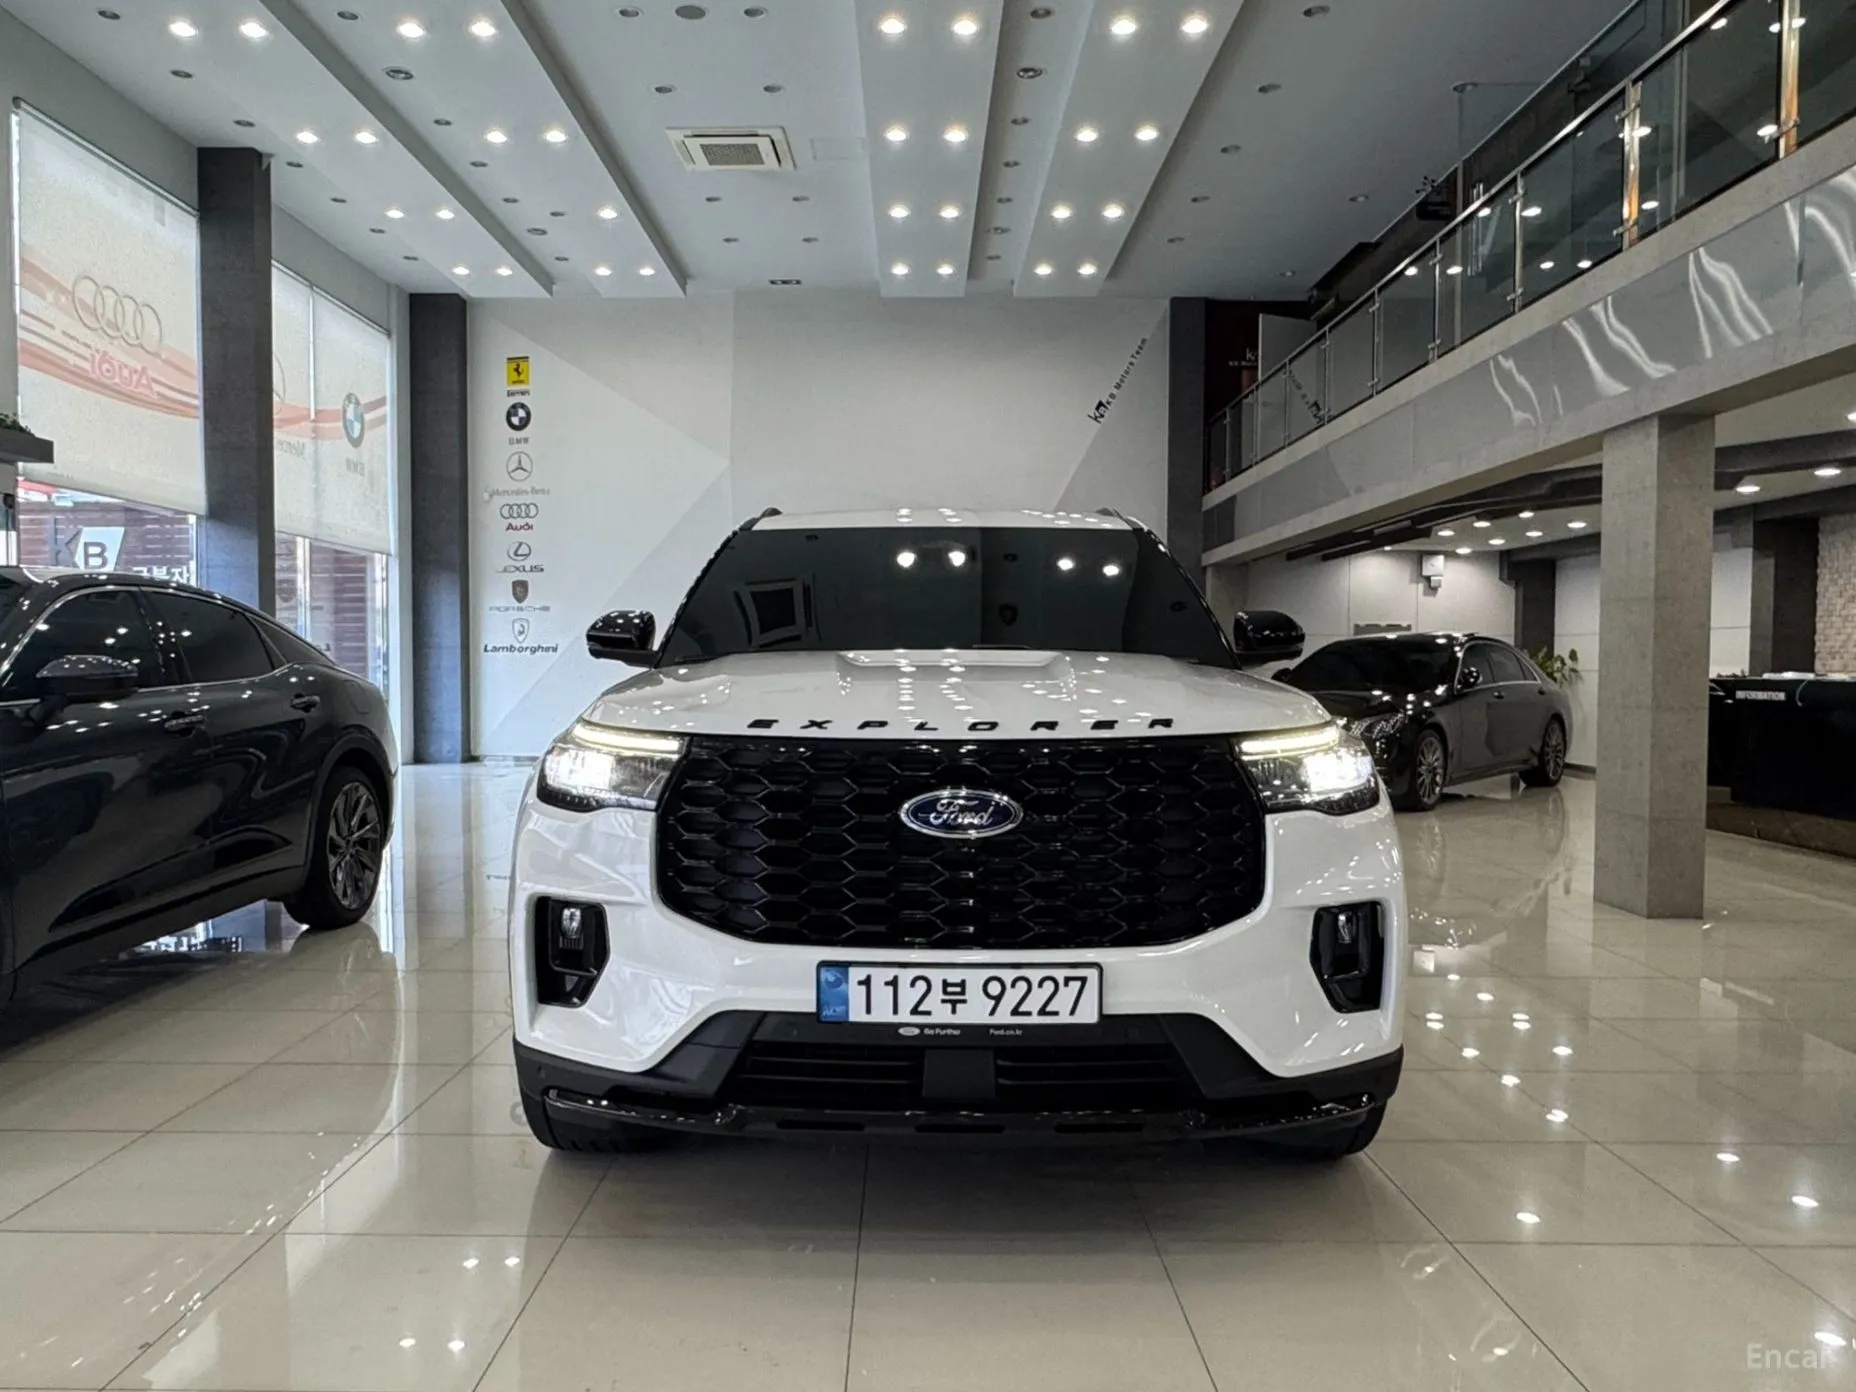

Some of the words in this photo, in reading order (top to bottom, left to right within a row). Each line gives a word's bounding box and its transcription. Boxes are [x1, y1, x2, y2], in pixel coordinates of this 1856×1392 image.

[505, 522, 534, 532] Audi
[483, 643, 559, 655] Lamborghini
[747, 718, 1174, 731] EXPLORER
[918, 799, 995, 826] Ford
[856, 974, 968, 1017] 112부
[981, 976, 1089, 1017] 9227
